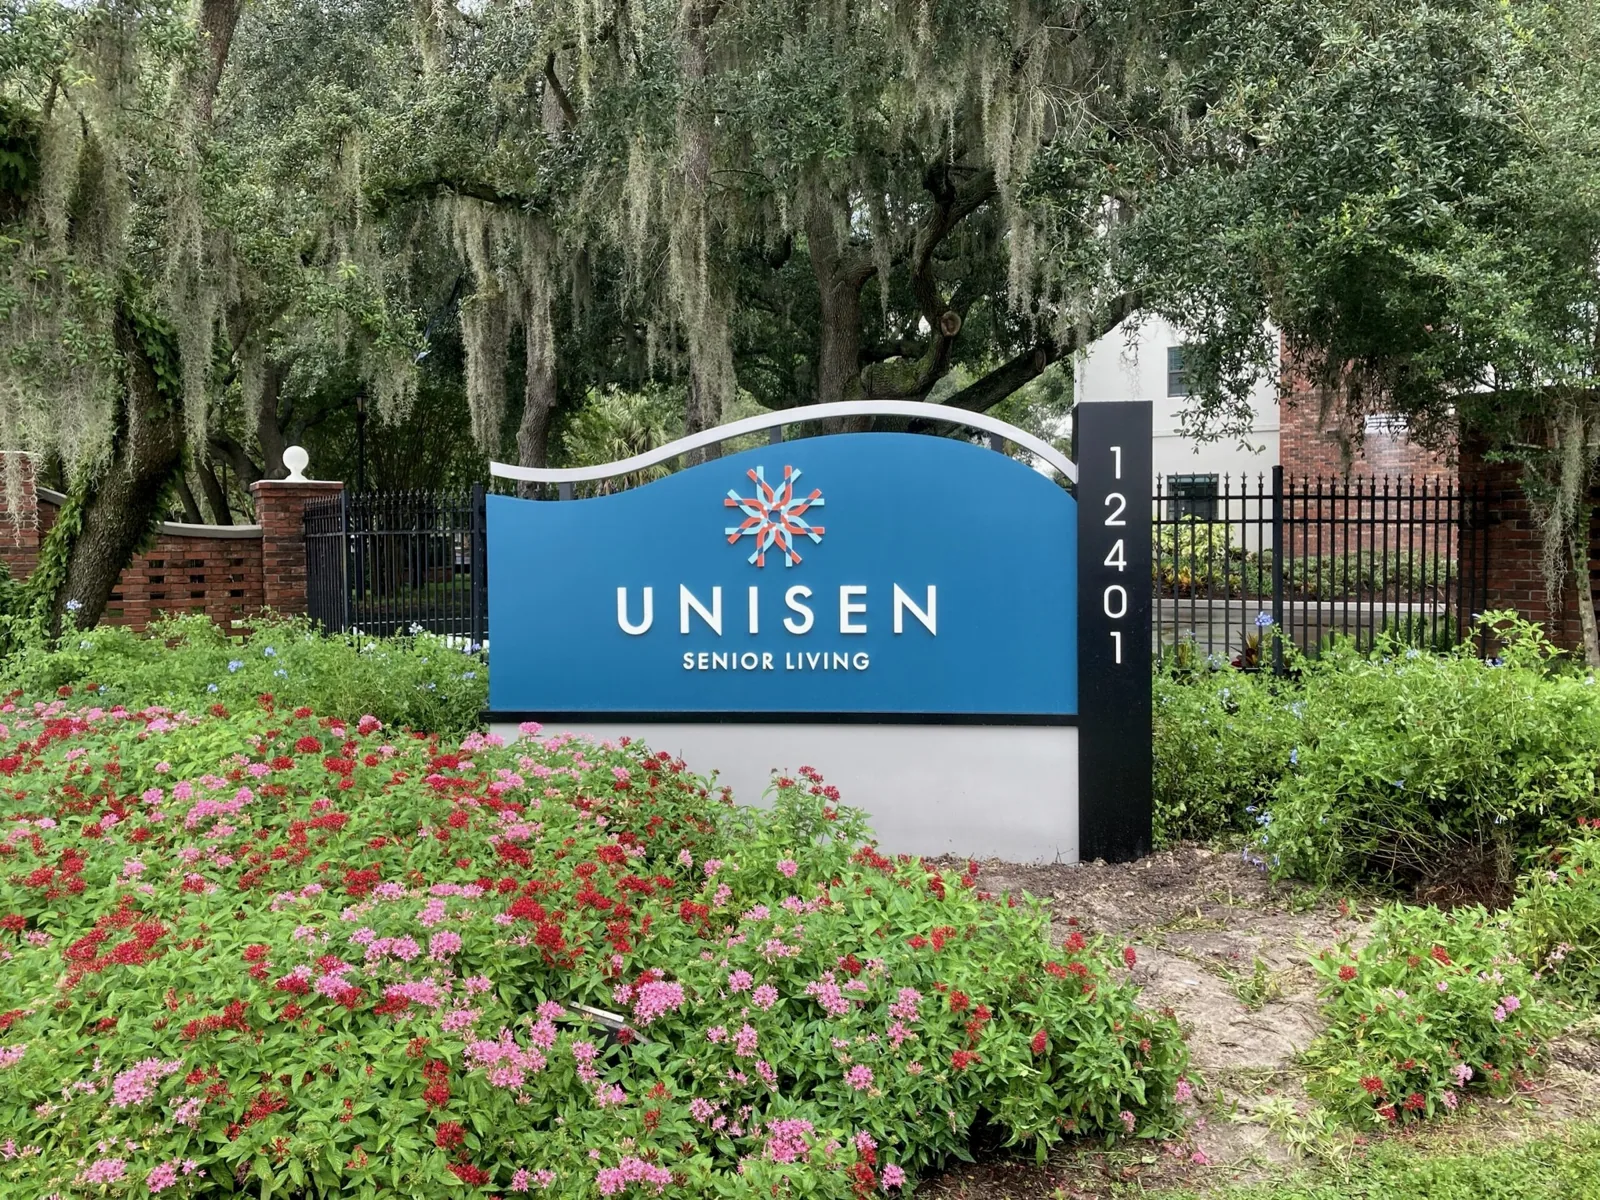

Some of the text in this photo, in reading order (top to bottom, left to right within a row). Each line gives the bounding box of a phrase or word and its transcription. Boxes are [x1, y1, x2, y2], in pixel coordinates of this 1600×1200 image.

[1103, 445, 1128, 664] 12401
[617, 583, 937, 636] UNISEN
[682, 652, 870, 670] SENIOR LIVING
